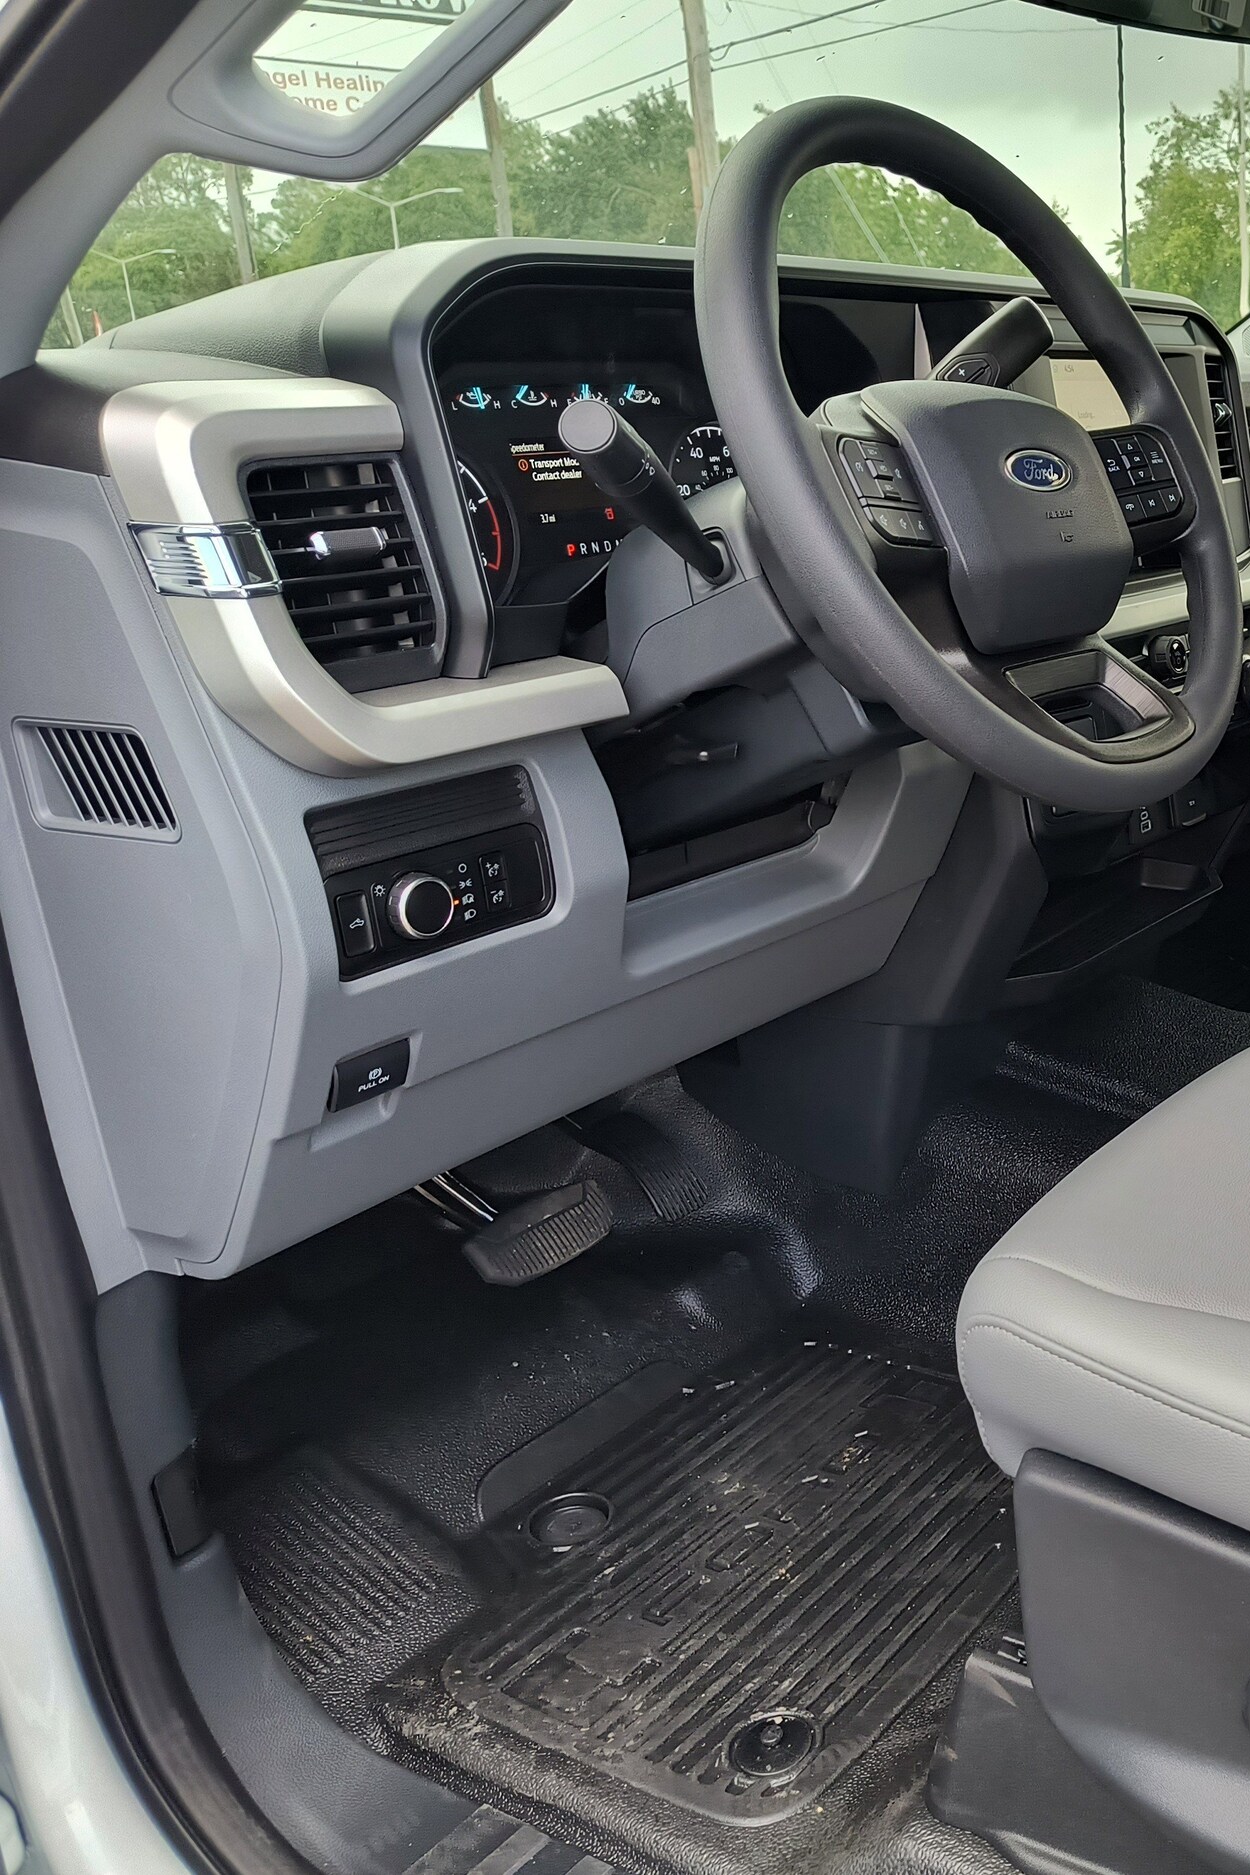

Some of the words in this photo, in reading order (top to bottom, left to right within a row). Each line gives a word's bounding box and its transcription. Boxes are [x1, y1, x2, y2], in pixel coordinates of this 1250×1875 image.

[264, 69, 308, 92] gel
[493, 400, 501, 410] H
[511, 400, 518, 409] C
[551, 399, 558, 408] H
[690, 447, 704, 459] 40
[529, 457, 564, 469] Transport
[532, 471, 560, 482] Contact
[560, 469, 583, 479] dealer
[1023, 458, 1059, 481] Ford
[676, 484, 691, 496] 20
[468, 498, 477, 513] 4
[566, 543, 575, 557] P
[579, 542, 588, 555] R
[591, 541, 600, 554] N
[604, 540, 612, 552] D
[358, 1080, 377, 1092] PULL
[378, 1074, 390, 1084] ON
